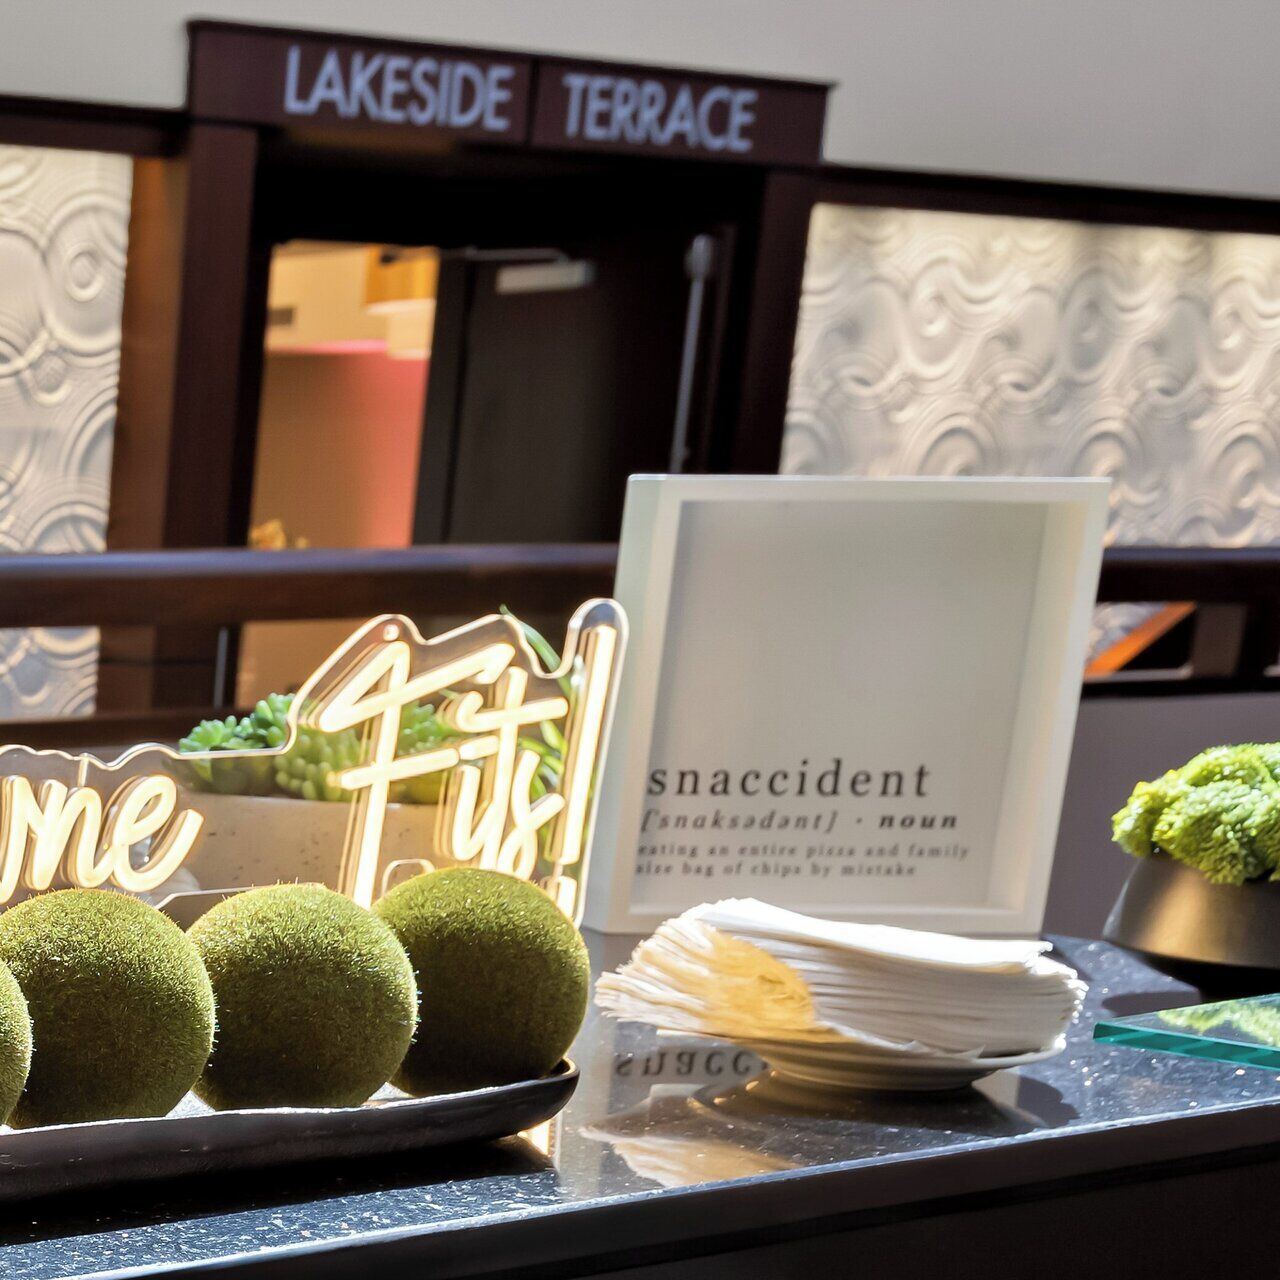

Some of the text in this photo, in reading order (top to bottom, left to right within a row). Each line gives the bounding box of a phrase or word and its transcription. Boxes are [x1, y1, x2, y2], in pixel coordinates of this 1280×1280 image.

[283, 45, 759, 152] LAKESIDE TERRACE
[646, 757, 931, 798] snaccident
[879, 814, 958, 830] noun
[638, 843, 699, 858] eating
[708, 845, 731, 856] an
[738, 843, 797, 857] entire
[864, 843, 900, 857] and
[907, 842, 971, 862] family
[681, 861, 715, 878] bag
[722, 859, 743, 875] of
[749, 861, 802, 878] chips
[810, 862, 830, 878] by
[841, 862, 915, 876] mistake
